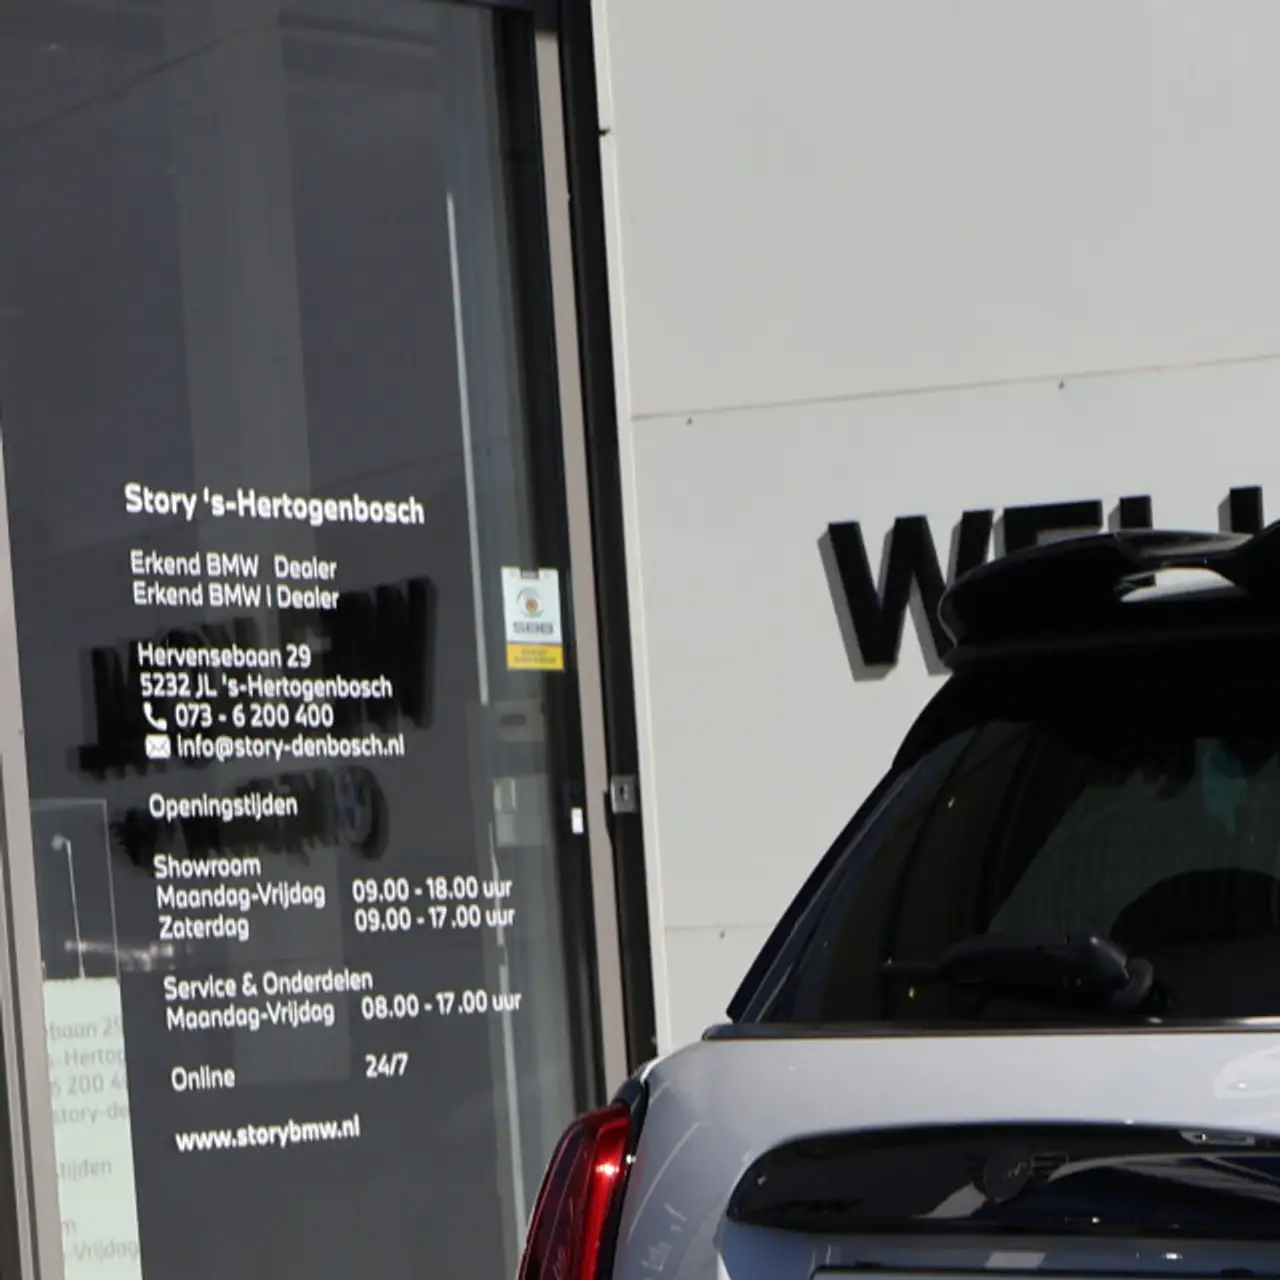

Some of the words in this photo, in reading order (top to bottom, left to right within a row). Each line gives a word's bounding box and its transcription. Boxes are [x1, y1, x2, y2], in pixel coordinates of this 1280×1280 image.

[124, 482, 198, 521] Story
[203, 486, 425, 526] 's-Hertogenbosch
[130, 549, 202, 577] Erkend
[205, 551, 259, 578] BMW
[273, 554, 337, 581] Dealer
[132, 580, 204, 607] Erkend
[207, 581, 262, 608] BMW
[276, 583, 340, 610] Dealer
[137, 642, 282, 668] Hervensebaan
[286, 643, 312, 668] 29
[140, 672, 191, 698] 5232
[195, 673, 218, 699] JL
[221, 673, 393, 702] 's-Hertogenbosch
[175, 702, 213, 728] 073
[232, 703, 246, 728] 6
[250, 702, 290, 728] 200
[294, 702, 334, 728] 400
[148, 792, 298, 822] Openingstijden
[153, 854, 262, 879] Showroom
[156, 881, 326, 912] Maandag-Vrijdag
[352, 878, 410, 904] 09.00
[425, 875, 479, 901] 18.00
[482, 877, 513, 900] uur
[158, 913, 250, 942] Zaterdag
[354, 906, 412, 933] 09.00
[485, 905, 516, 928] uur
[163, 974, 237, 1001] Service
[241, 971, 259, 998] &
[262, 970, 374, 998] Onderdelen
[166, 1001, 336, 1032] Maandag-Vrijdag
[361, 993, 420, 1020] 08.00
[491, 990, 523, 1013] uur
[171, 1064, 236, 1092] Online
[365, 1051, 409, 1078] 24/7
[175, 1113, 361, 1152] www.storybmw.nl
